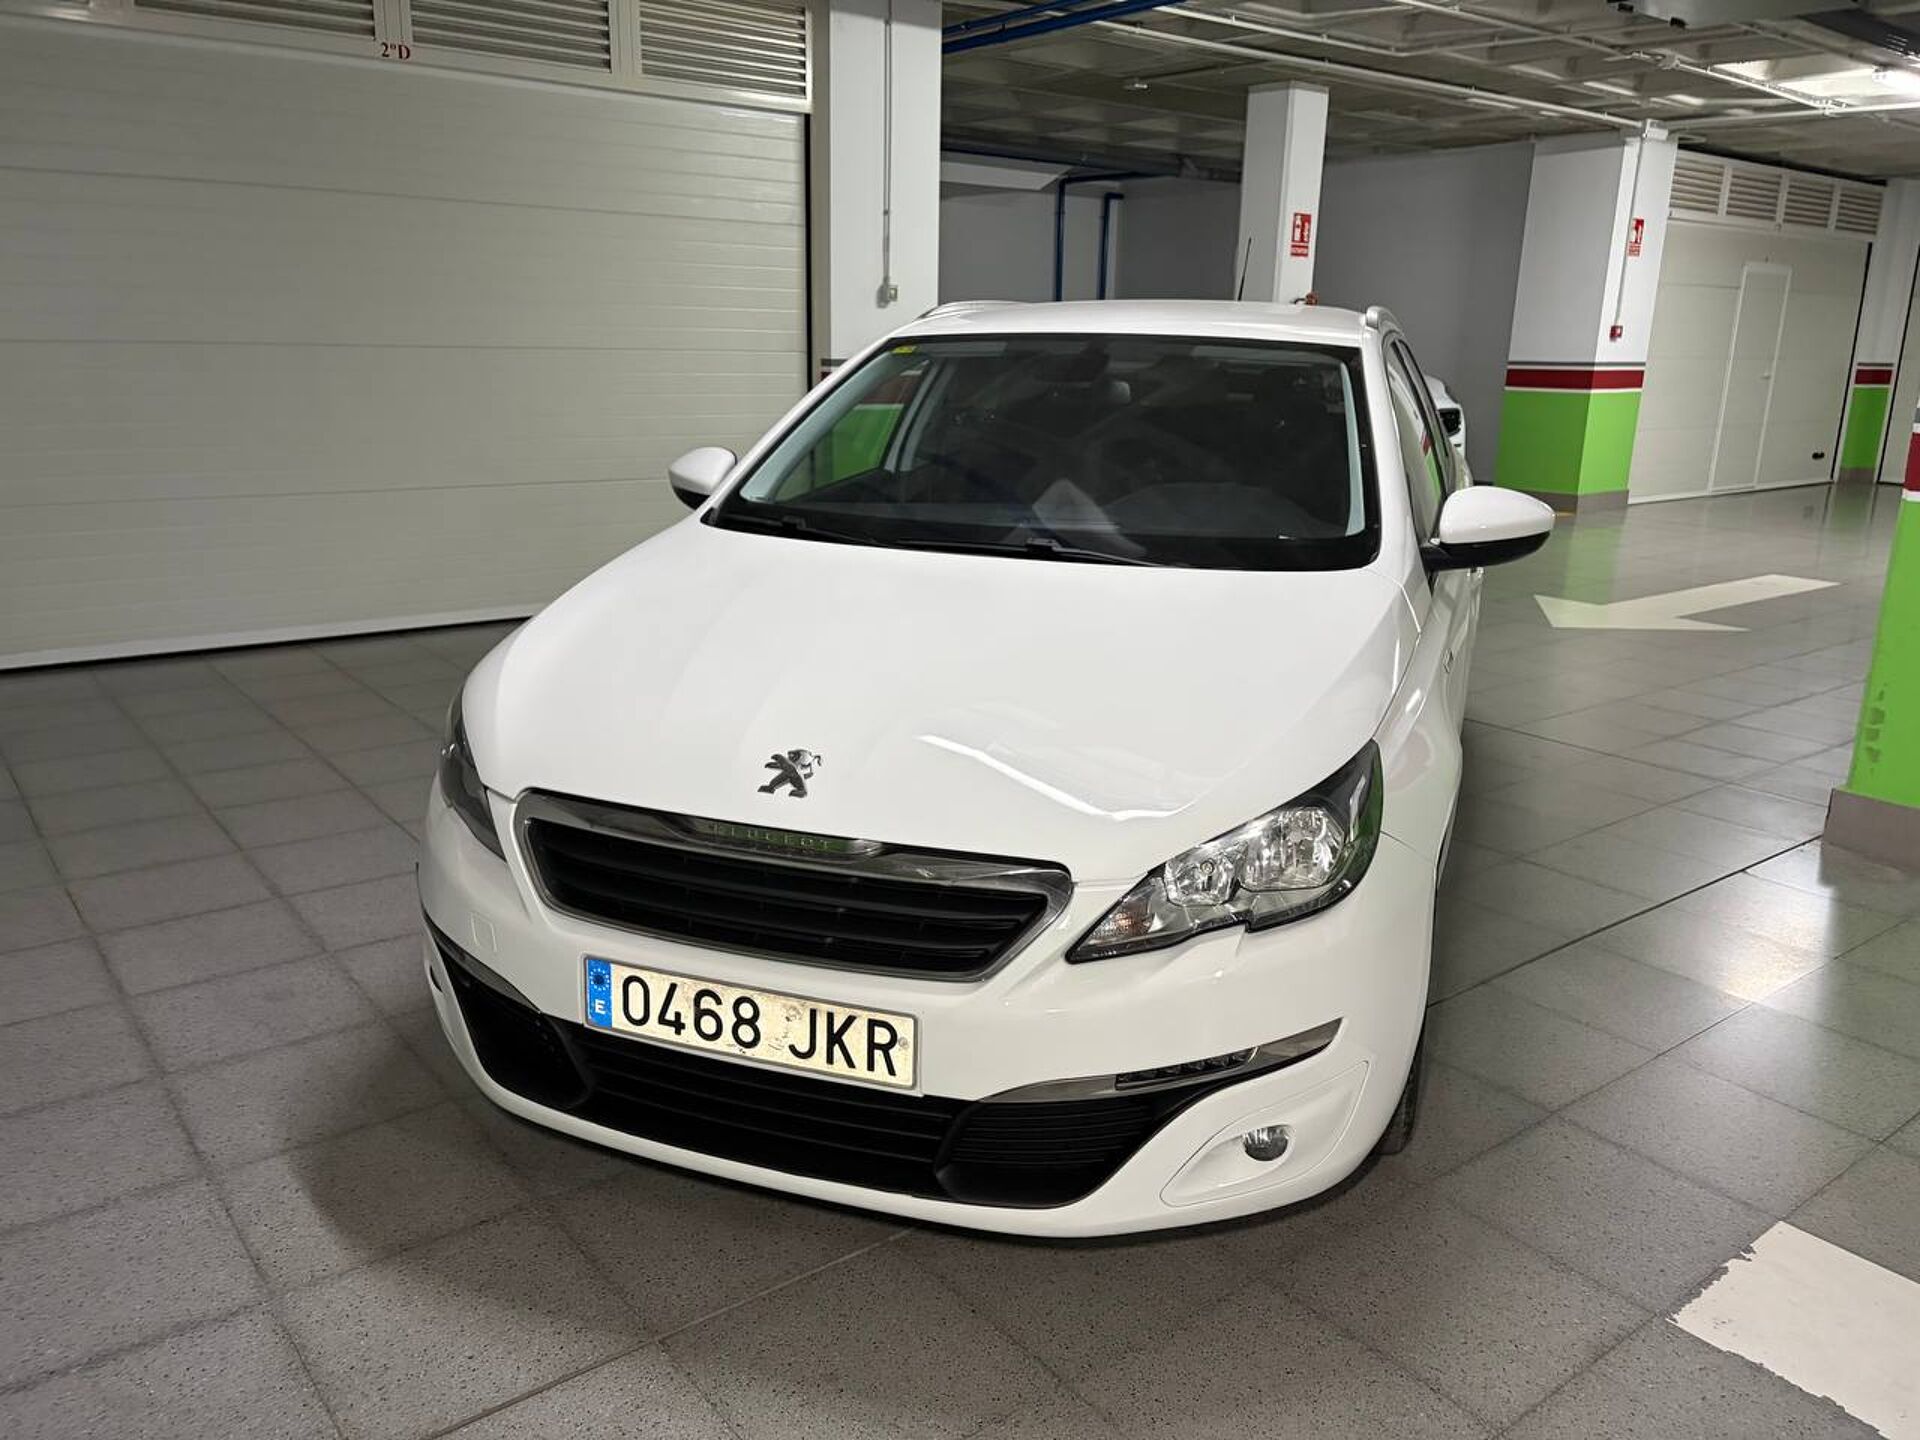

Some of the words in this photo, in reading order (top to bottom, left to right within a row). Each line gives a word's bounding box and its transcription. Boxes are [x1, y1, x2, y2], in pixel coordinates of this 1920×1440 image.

[594, 999, 606, 1015] E
[622, 975, 761, 1049] 0468
[789, 1008, 899, 1077] JKR
